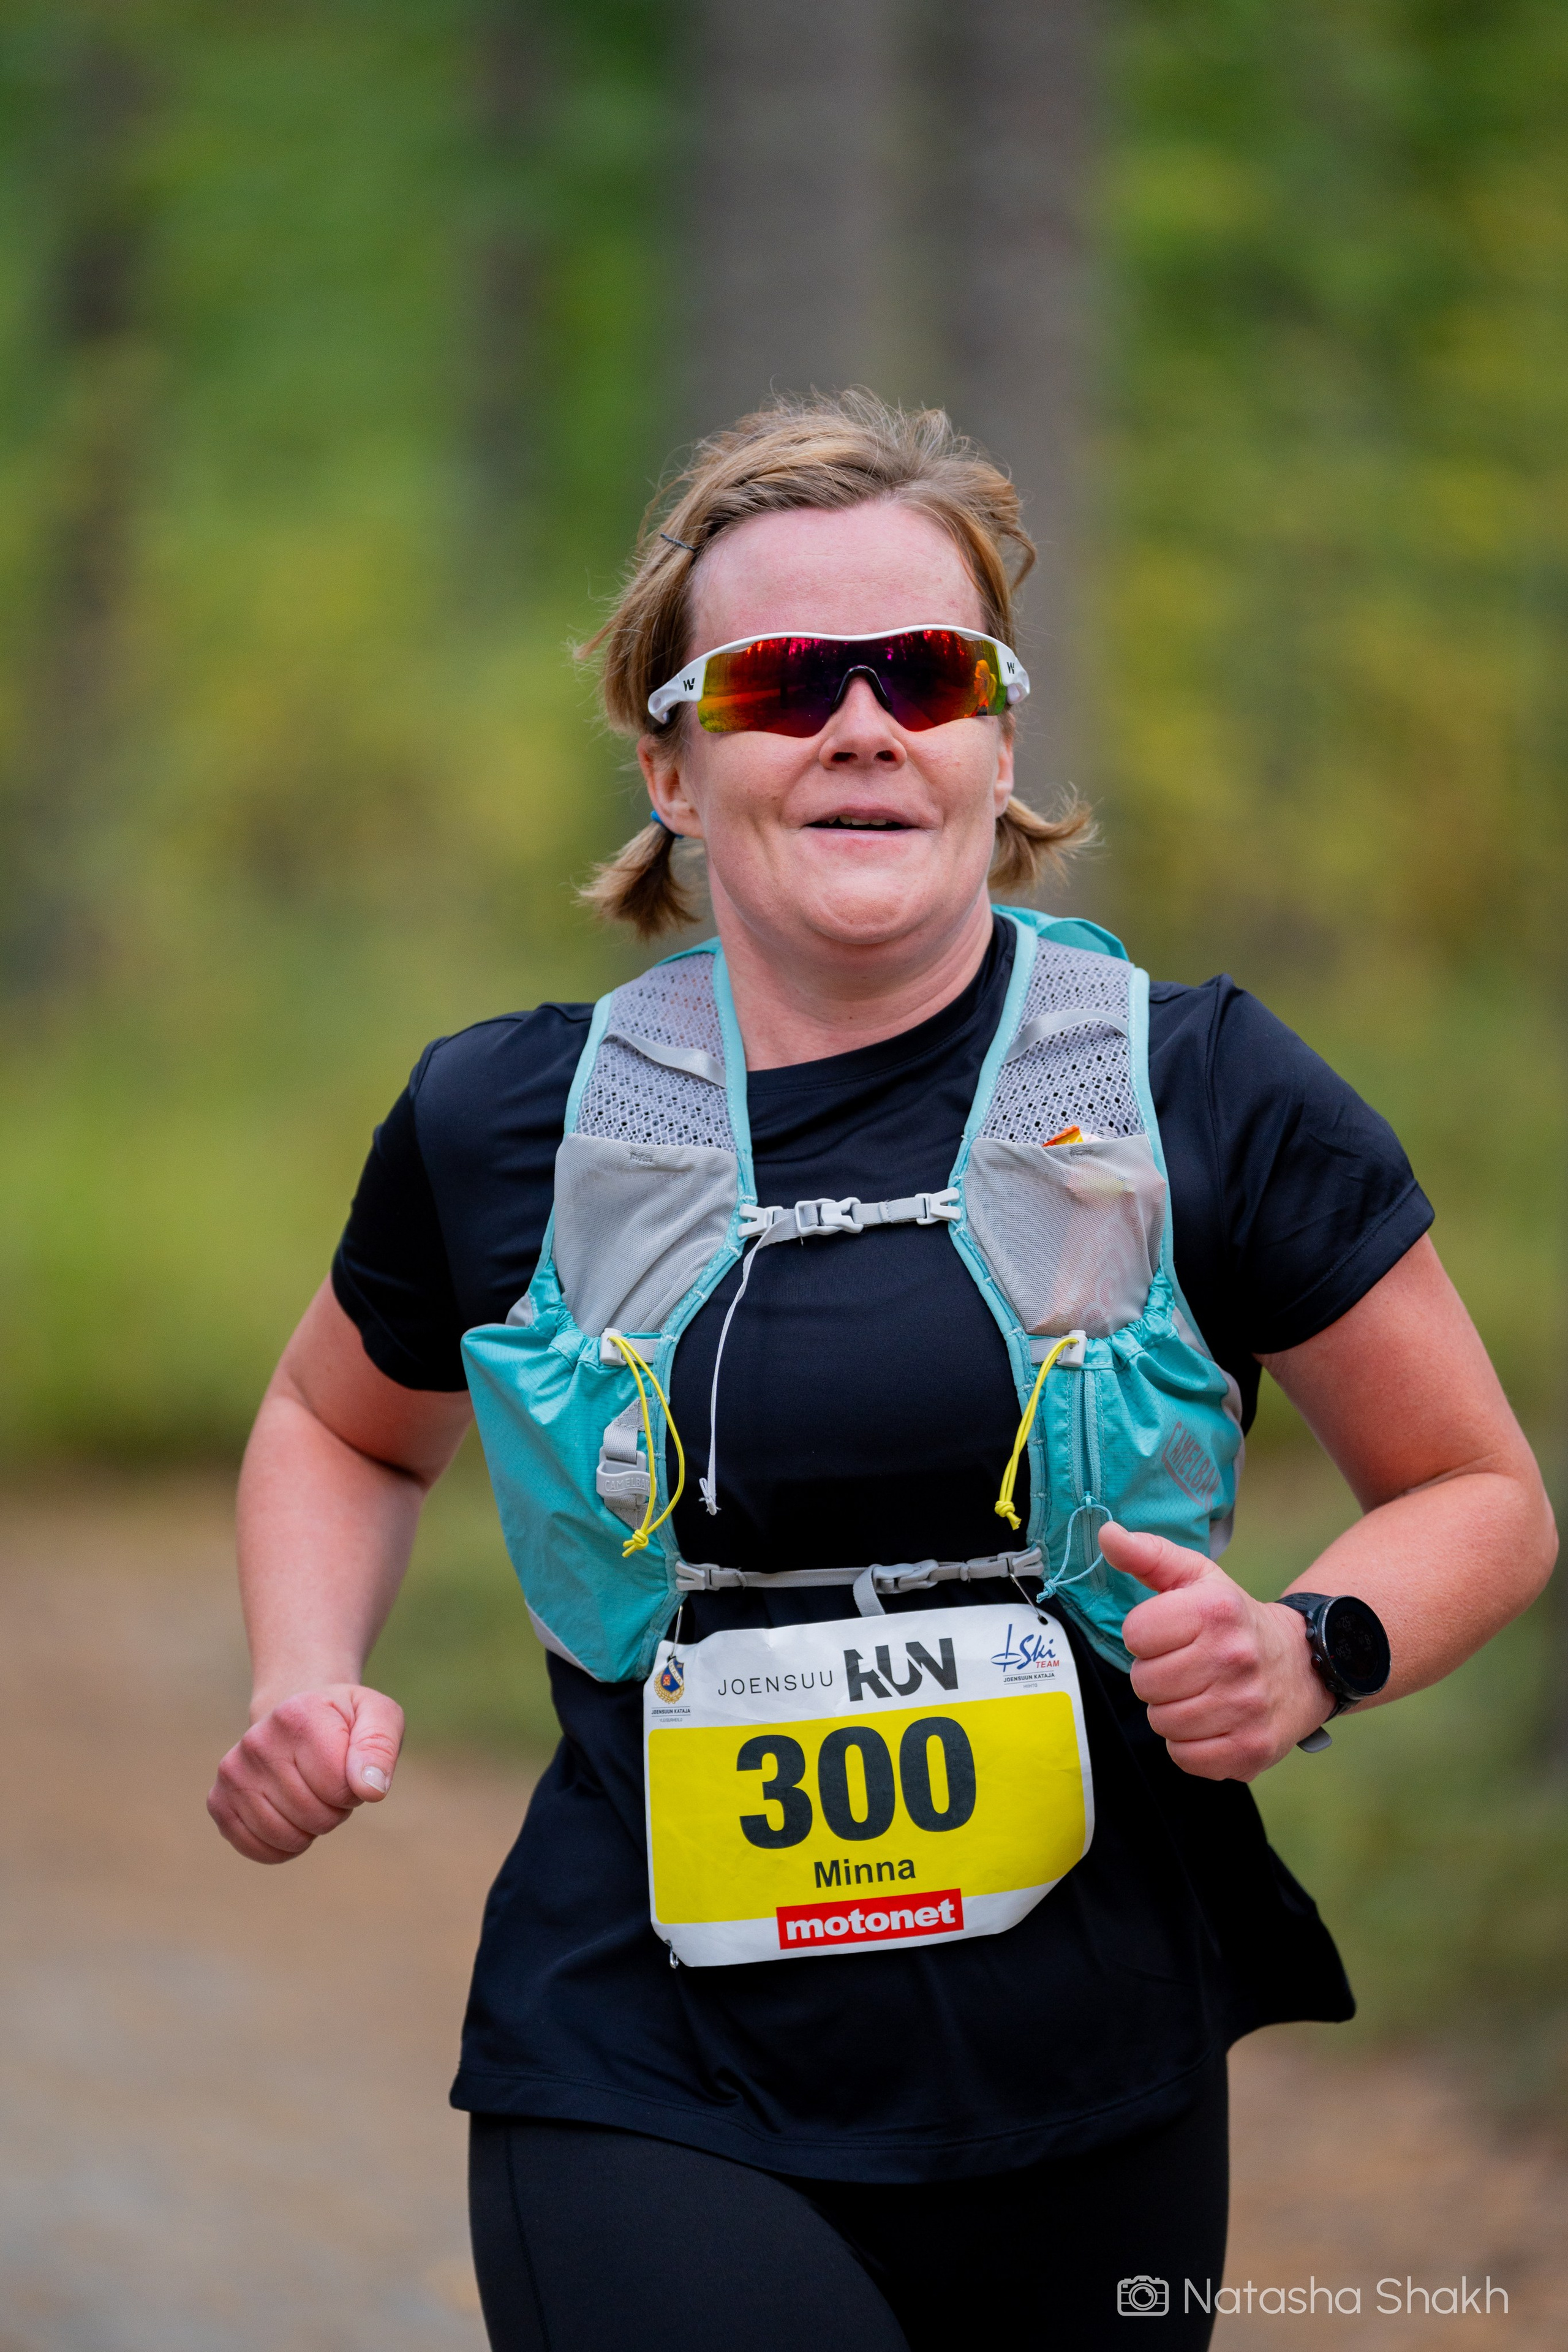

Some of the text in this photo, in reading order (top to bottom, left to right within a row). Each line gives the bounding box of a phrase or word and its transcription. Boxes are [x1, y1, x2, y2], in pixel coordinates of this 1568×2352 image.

[1161, 1421, 1222, 1512] CAMELBAK
[718, 1638, 959, 1702] JOENSUU RUN
[1036, 1660, 1060, 1668] TEAM
[736, 1717, 977, 1850] 300
[813, 1858, 916, 1888] Minna
[785, 1899, 956, 1940] motonet
